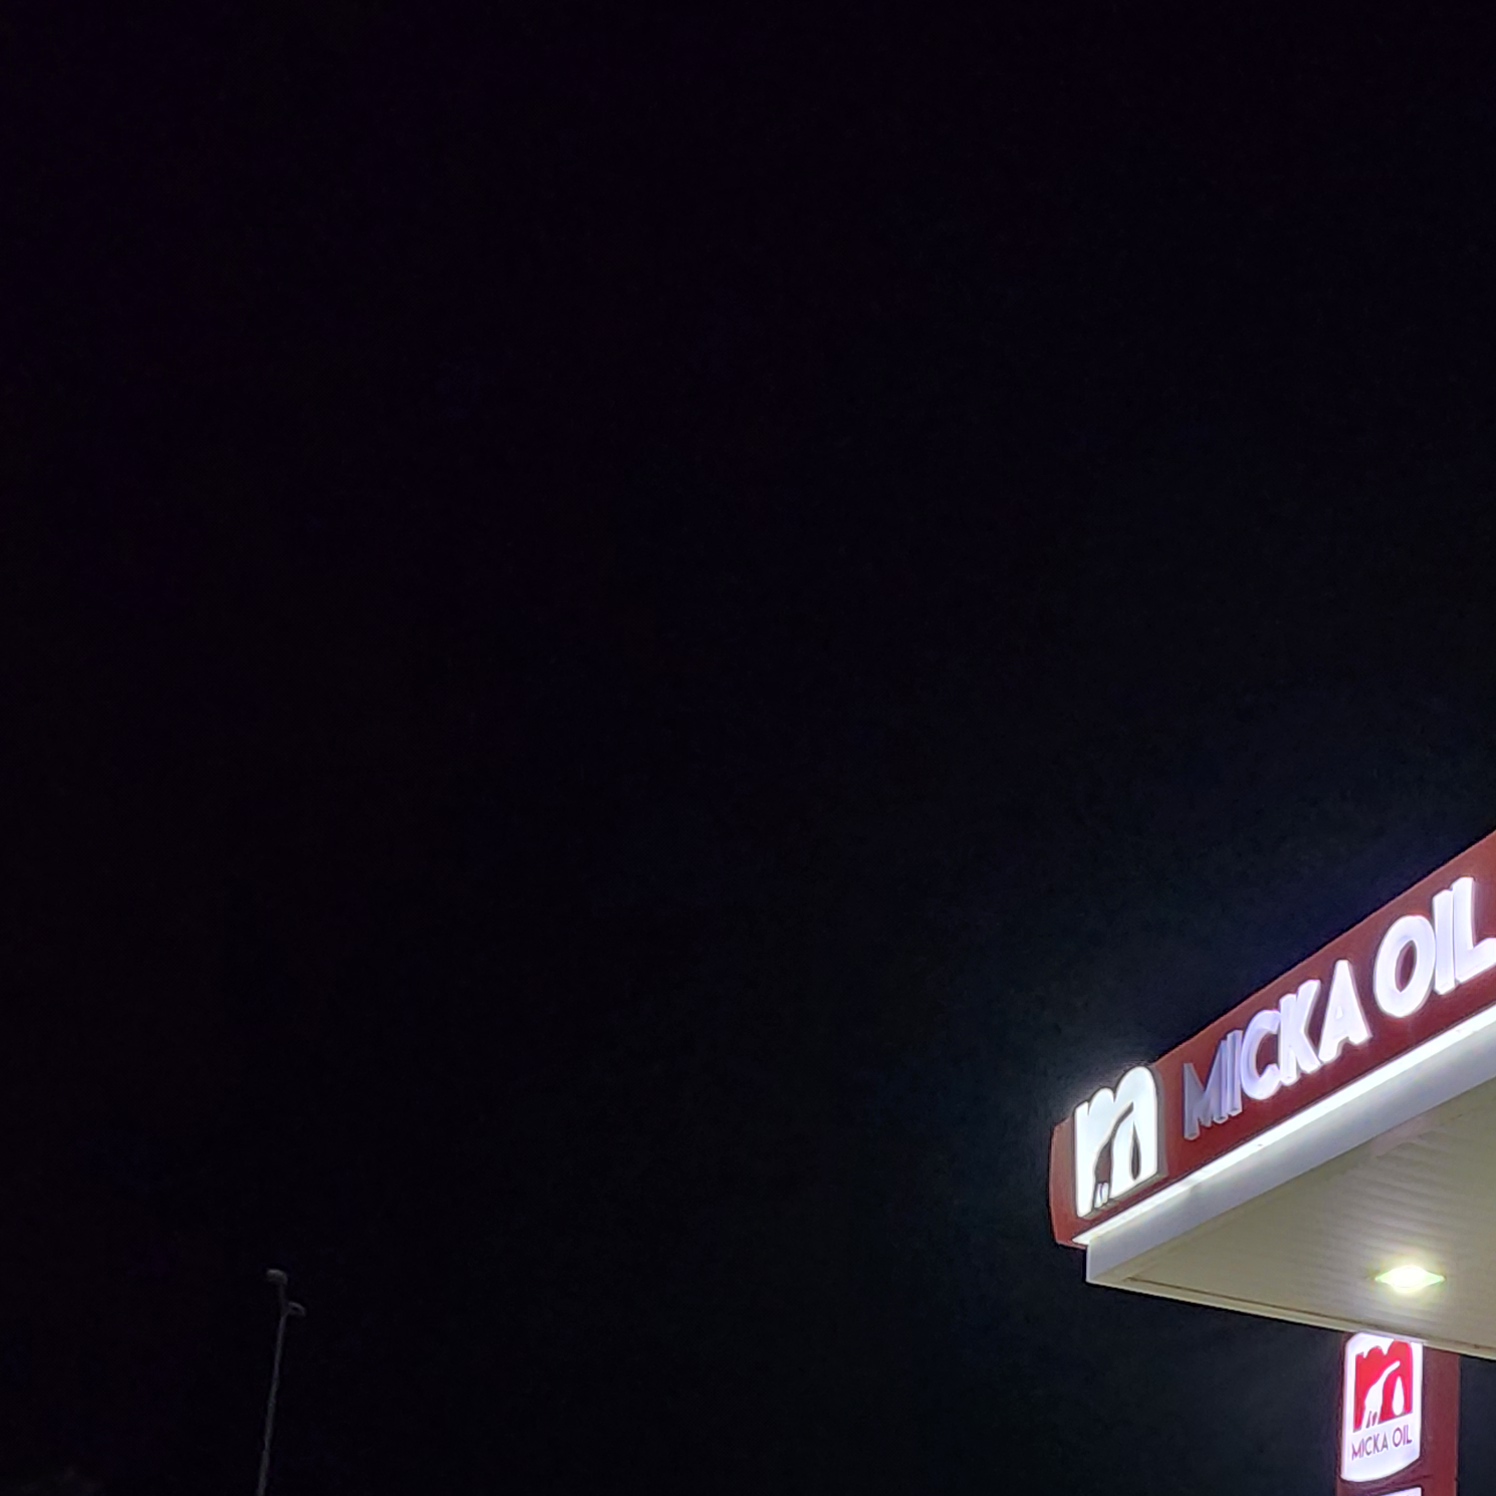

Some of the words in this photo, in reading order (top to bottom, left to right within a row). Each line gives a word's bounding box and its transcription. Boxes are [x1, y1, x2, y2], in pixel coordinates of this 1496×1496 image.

[1183, 959, 1372, 1140] MICKA
[1351, 1431, 1389, 1461] MICKA
[1392, 1424, 1413, 1448] OIL
